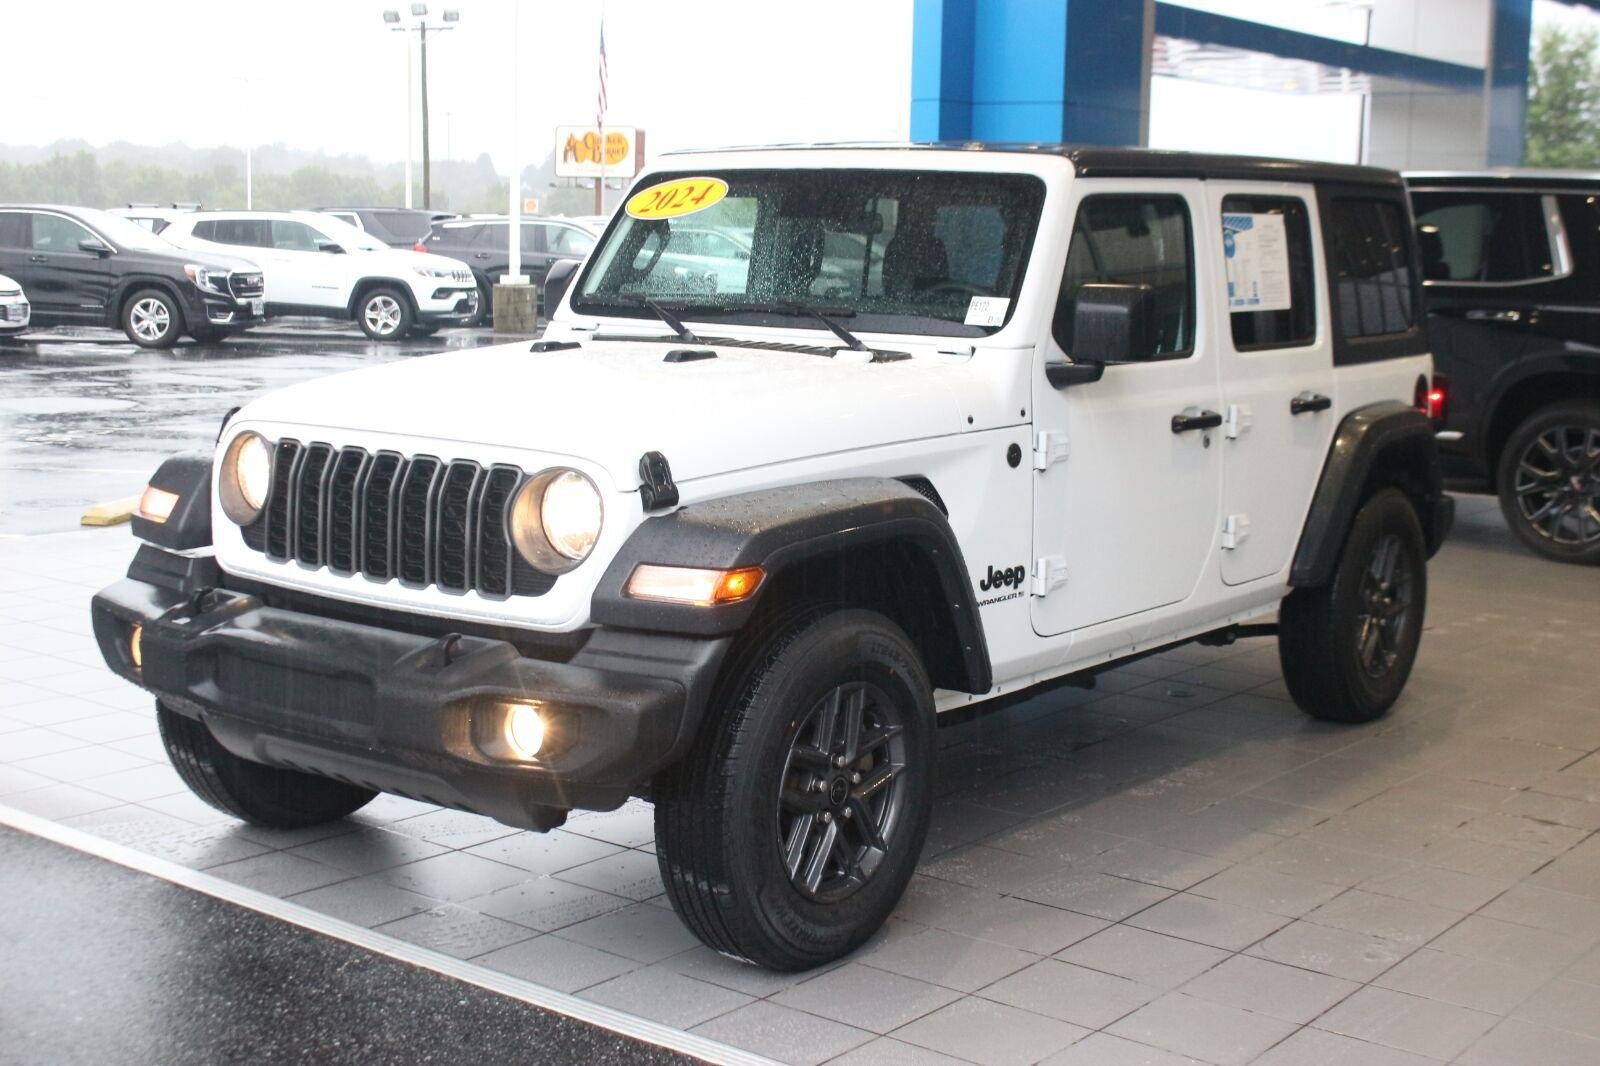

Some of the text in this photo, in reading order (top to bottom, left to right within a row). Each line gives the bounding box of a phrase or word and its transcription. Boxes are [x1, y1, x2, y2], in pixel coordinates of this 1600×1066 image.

[638, 183, 715, 213] 2024
[980, 565, 1025, 591] Jeep
[977, 593, 1017, 607] WRANGLER
